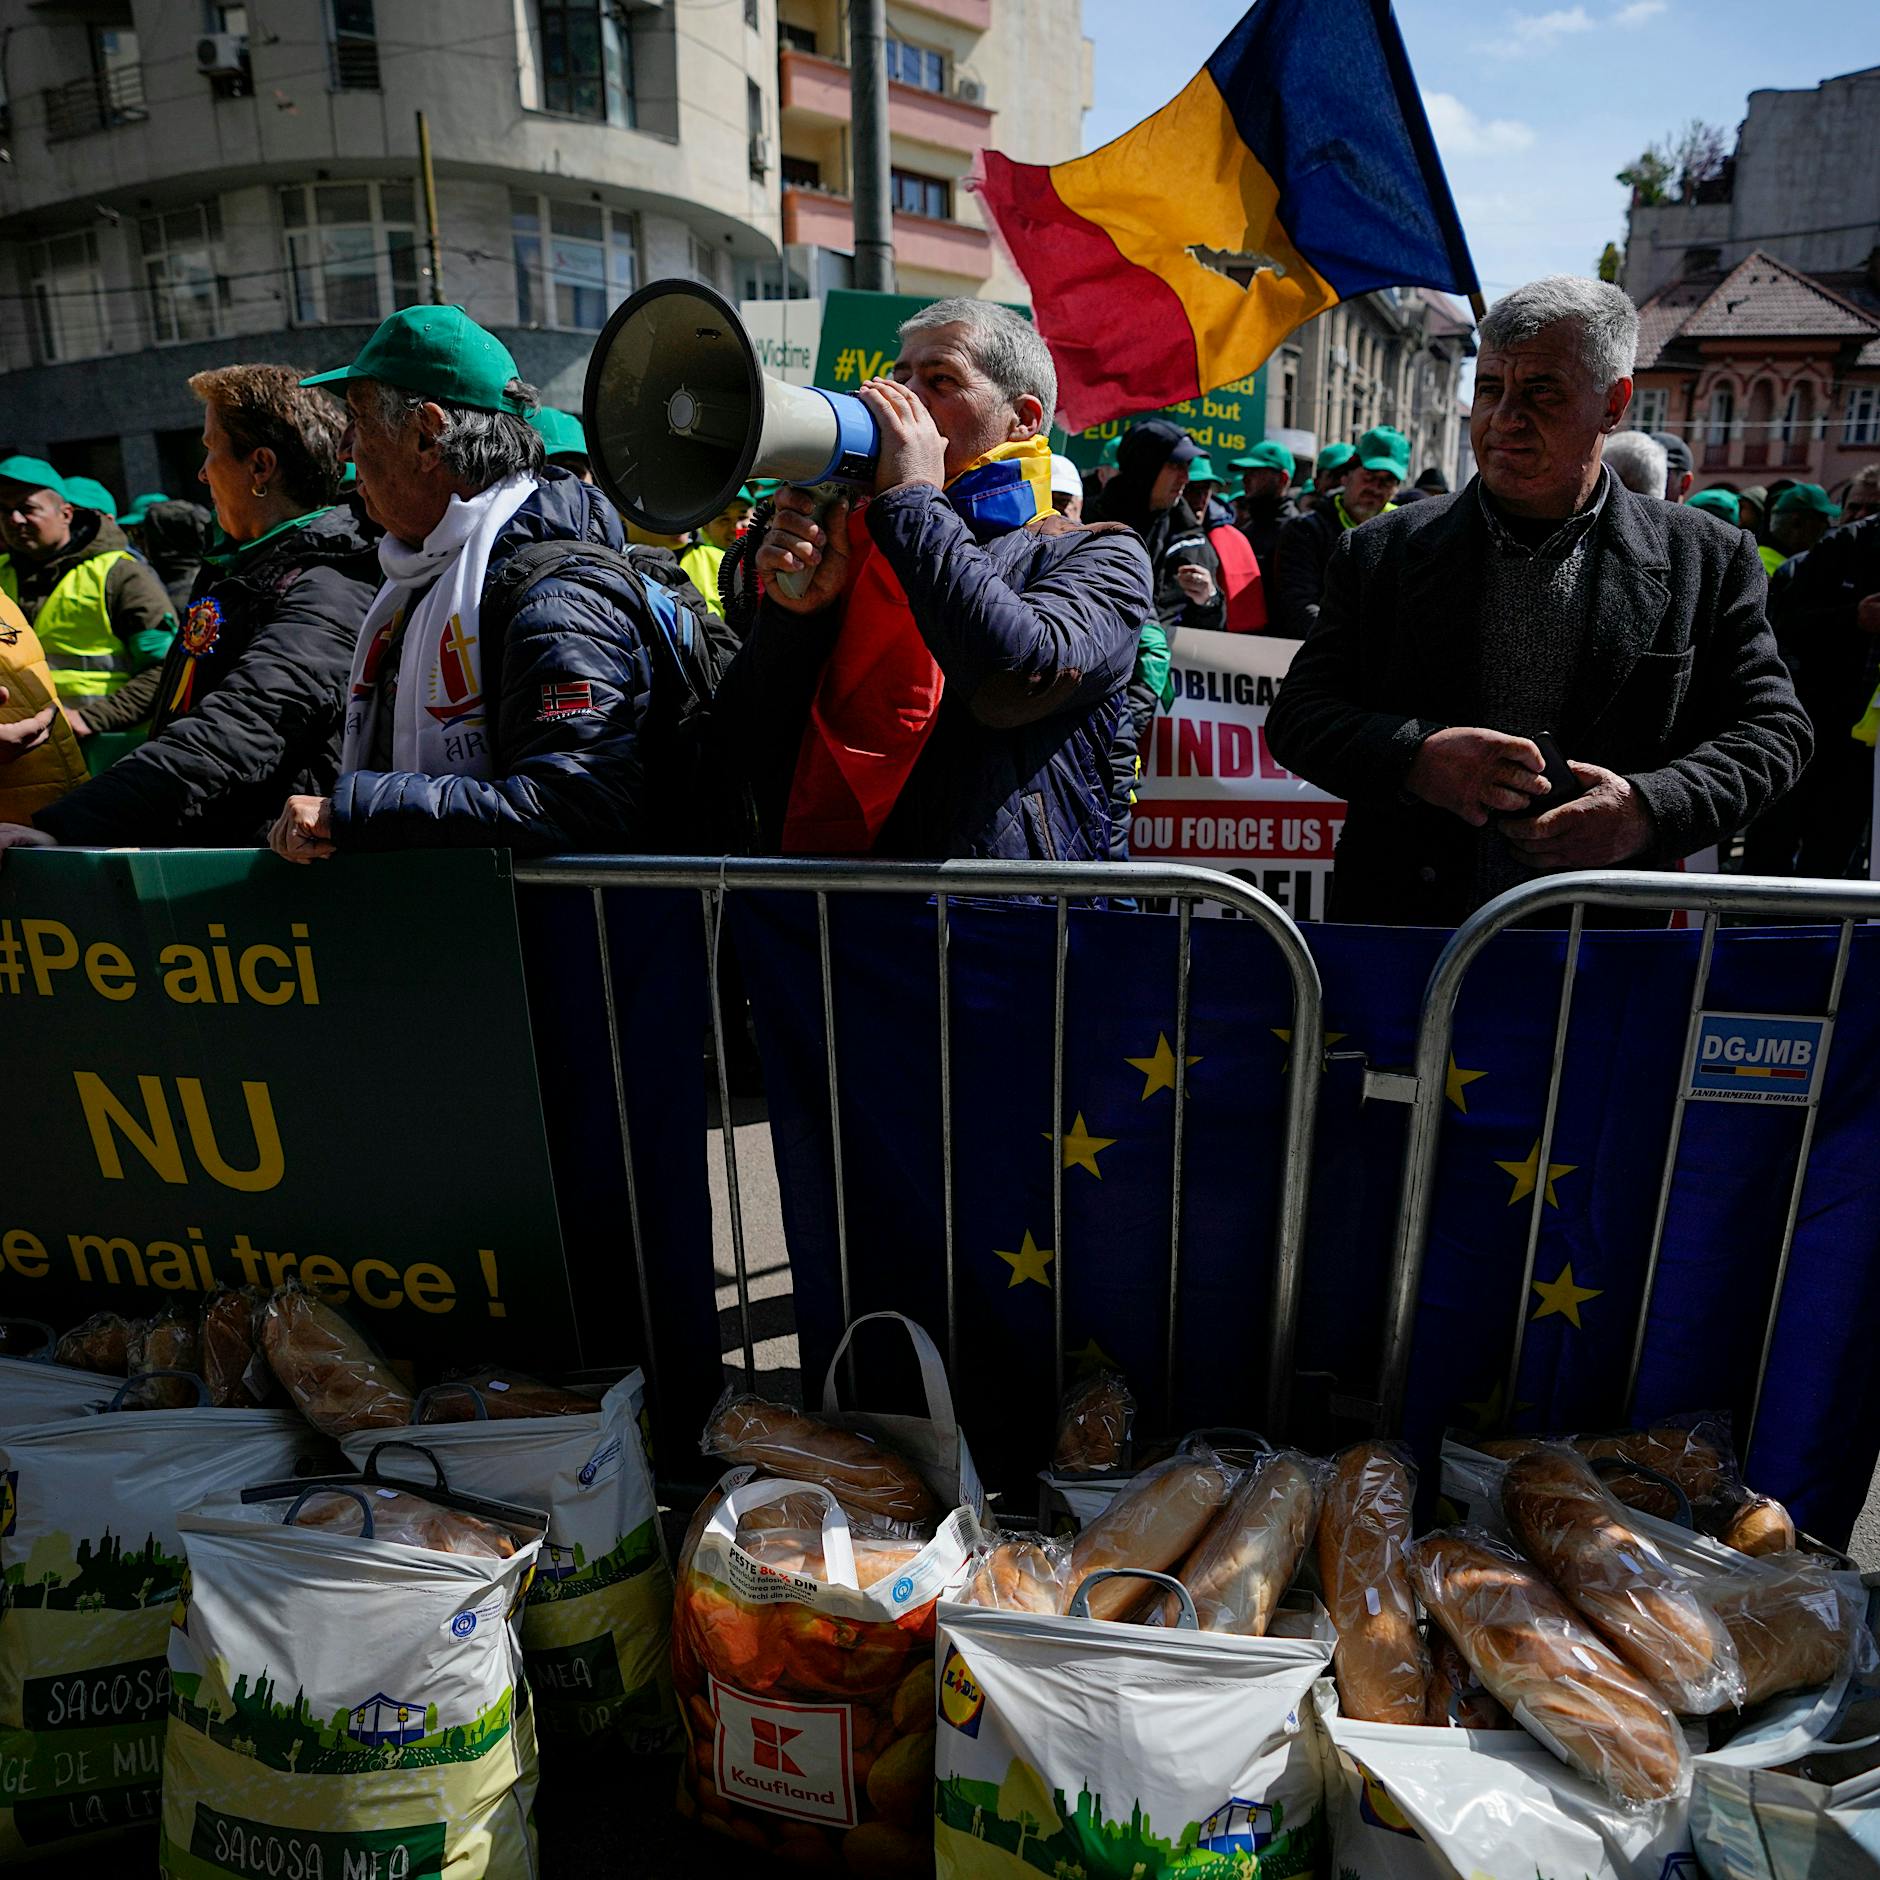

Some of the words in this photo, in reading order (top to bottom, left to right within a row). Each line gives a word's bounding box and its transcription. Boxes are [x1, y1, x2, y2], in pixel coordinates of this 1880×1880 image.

[1202, 397, 1241, 421] but
[1083, 420, 1118, 440] EU
[1218, 431, 1246, 451] us
[1171, 667, 1284, 706] OBLIGA
[1131, 816, 1174, 849] OU
[1181, 817, 1274, 850] FORCE
[1281, 819, 1322, 851] US
[0, 918, 137, 1001] #Pe
[159, 923, 320, 1005] aici
[1701, 1035, 1813, 1065] DGJMB
[1690, 1089, 1763, 1101] JANDARMERIA
[1764, 1094, 1809, 1103] ROMANA
[73, 1071, 285, 1192] NU
[0, 1226, 50, 1279] e
[67, 1226, 213, 1292] mai
[230, 1234, 457, 1316] trece
[729, 1547, 757, 1575] PESTE
[794, 1578, 817, 1592] DIN
[0, 1753, 37, 1793] GE
[54, 1750, 98, 1788] DE
[113, 1735, 162, 1778] MU
[731, 1765, 835, 1805] Kaufland
[68, 1794, 109, 1828] LA
